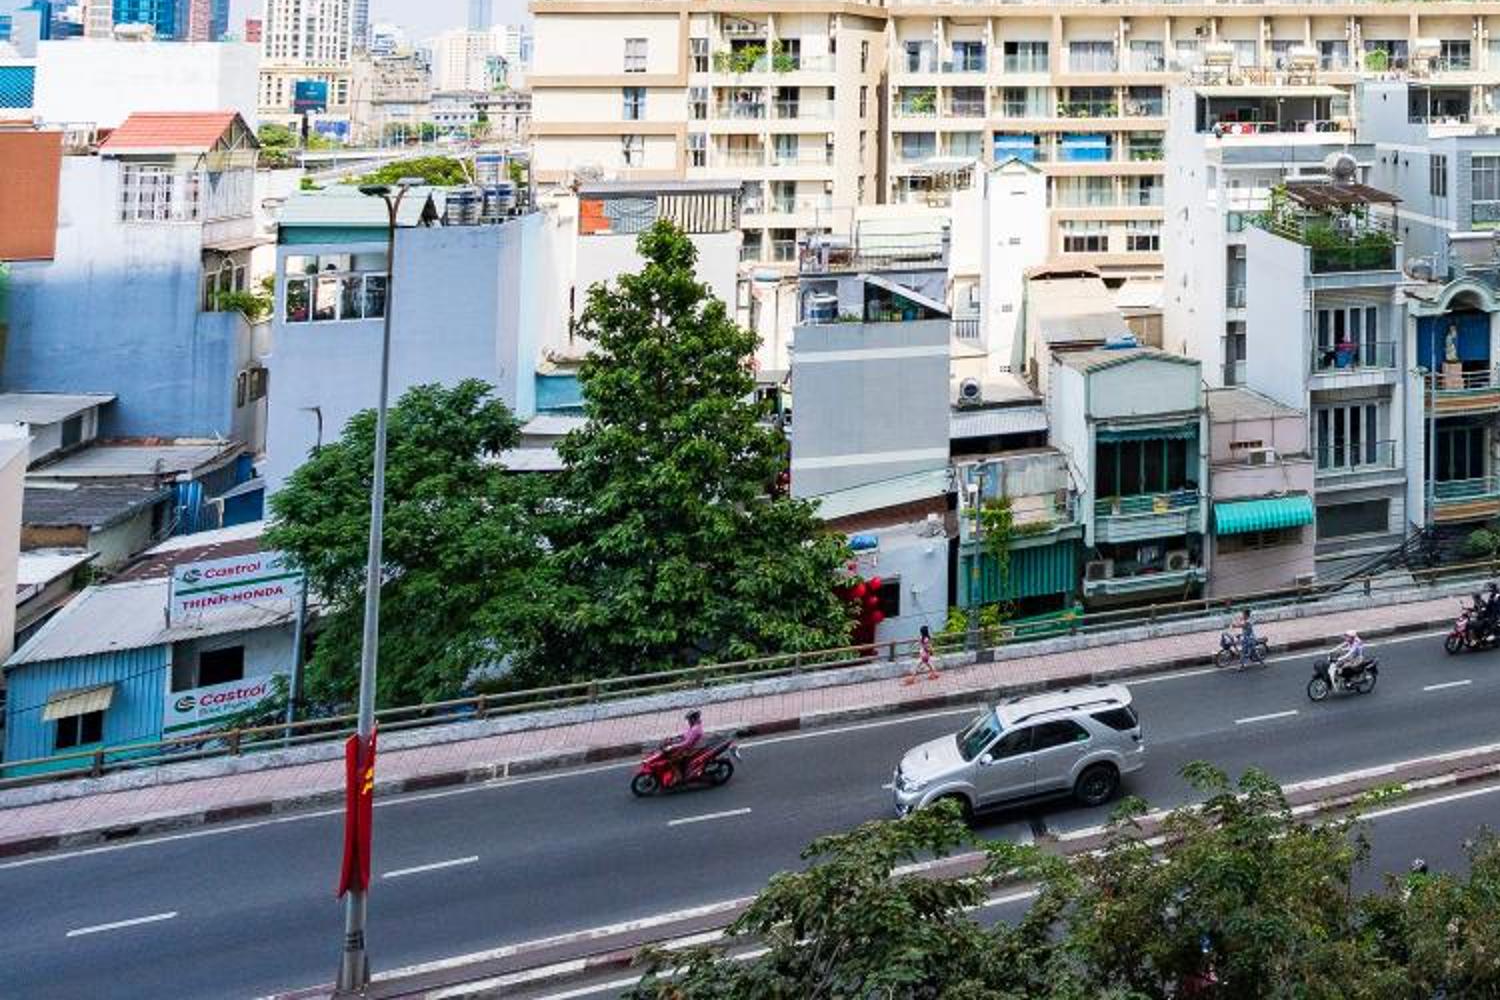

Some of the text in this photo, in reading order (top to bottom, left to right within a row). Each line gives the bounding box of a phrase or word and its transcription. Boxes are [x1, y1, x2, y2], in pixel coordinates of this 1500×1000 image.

[204, 561, 261, 579] Castrol
[232, 585, 283, 601] HONDA
[199, 683, 267, 707] Castrol
